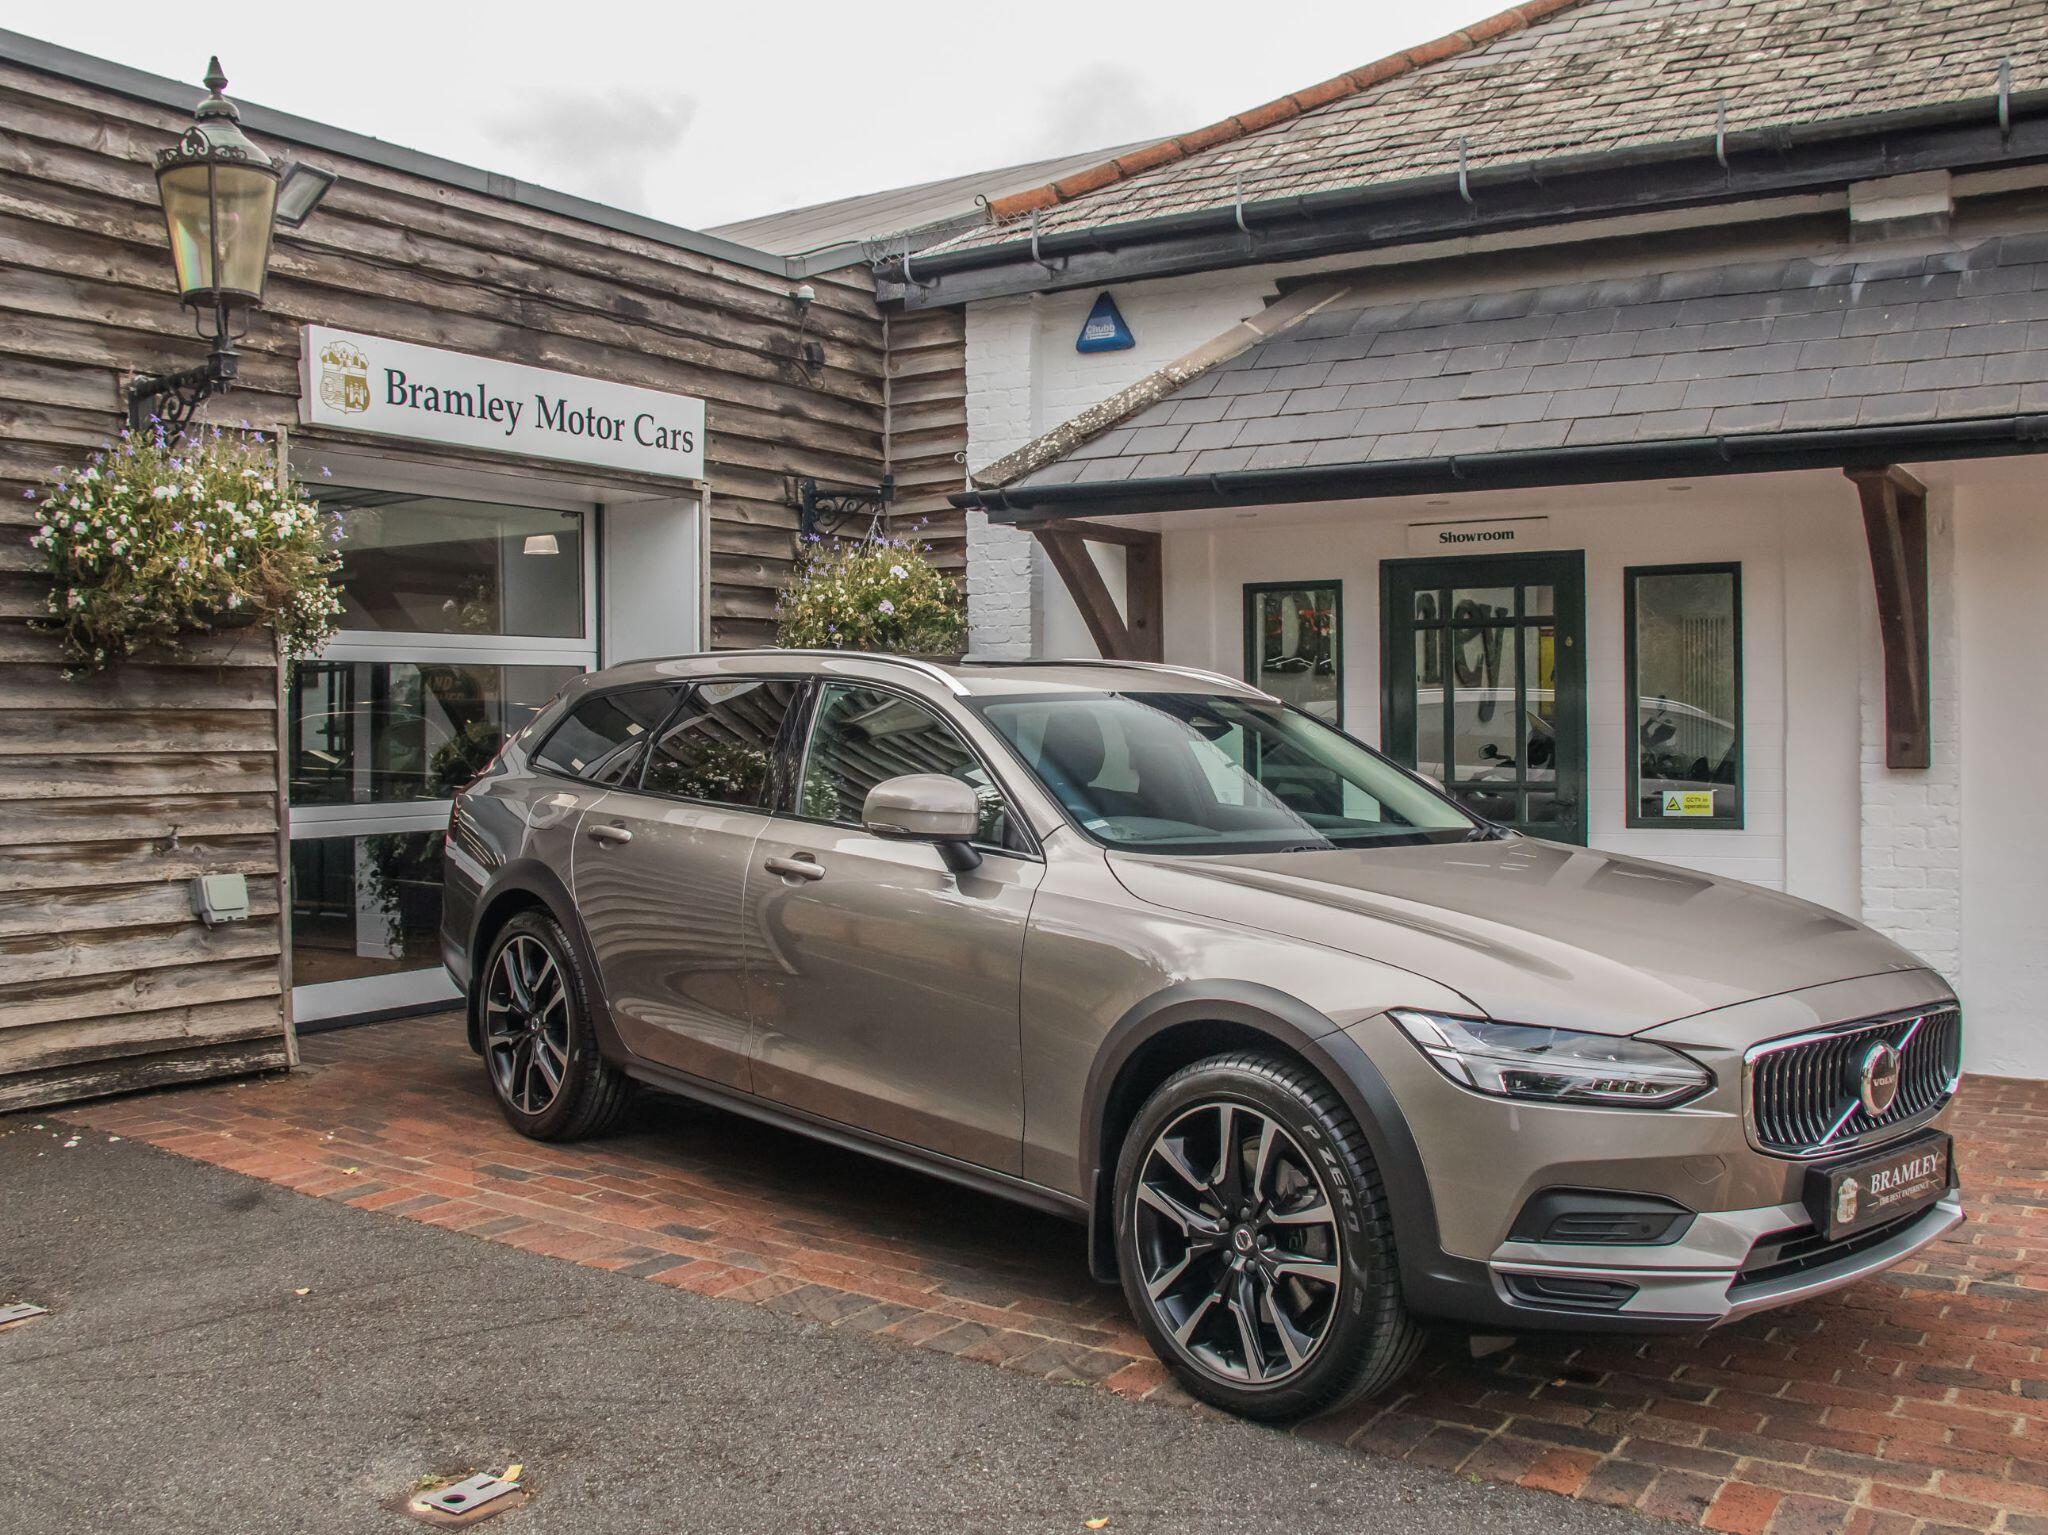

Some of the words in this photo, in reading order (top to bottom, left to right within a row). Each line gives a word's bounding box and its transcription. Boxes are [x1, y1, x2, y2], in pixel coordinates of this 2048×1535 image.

[384, 368, 522, 436] Bramley
[535, 395, 625, 441] Motor
[634, 413, 694, 453] Cars
[1439, 530, 1514, 544] Showroom
[1302, 1124, 1321, 1140] P
[1318, 1147, 1360, 1233] ZERO
[1870, 1152, 1939, 1195] BRAMLEY
